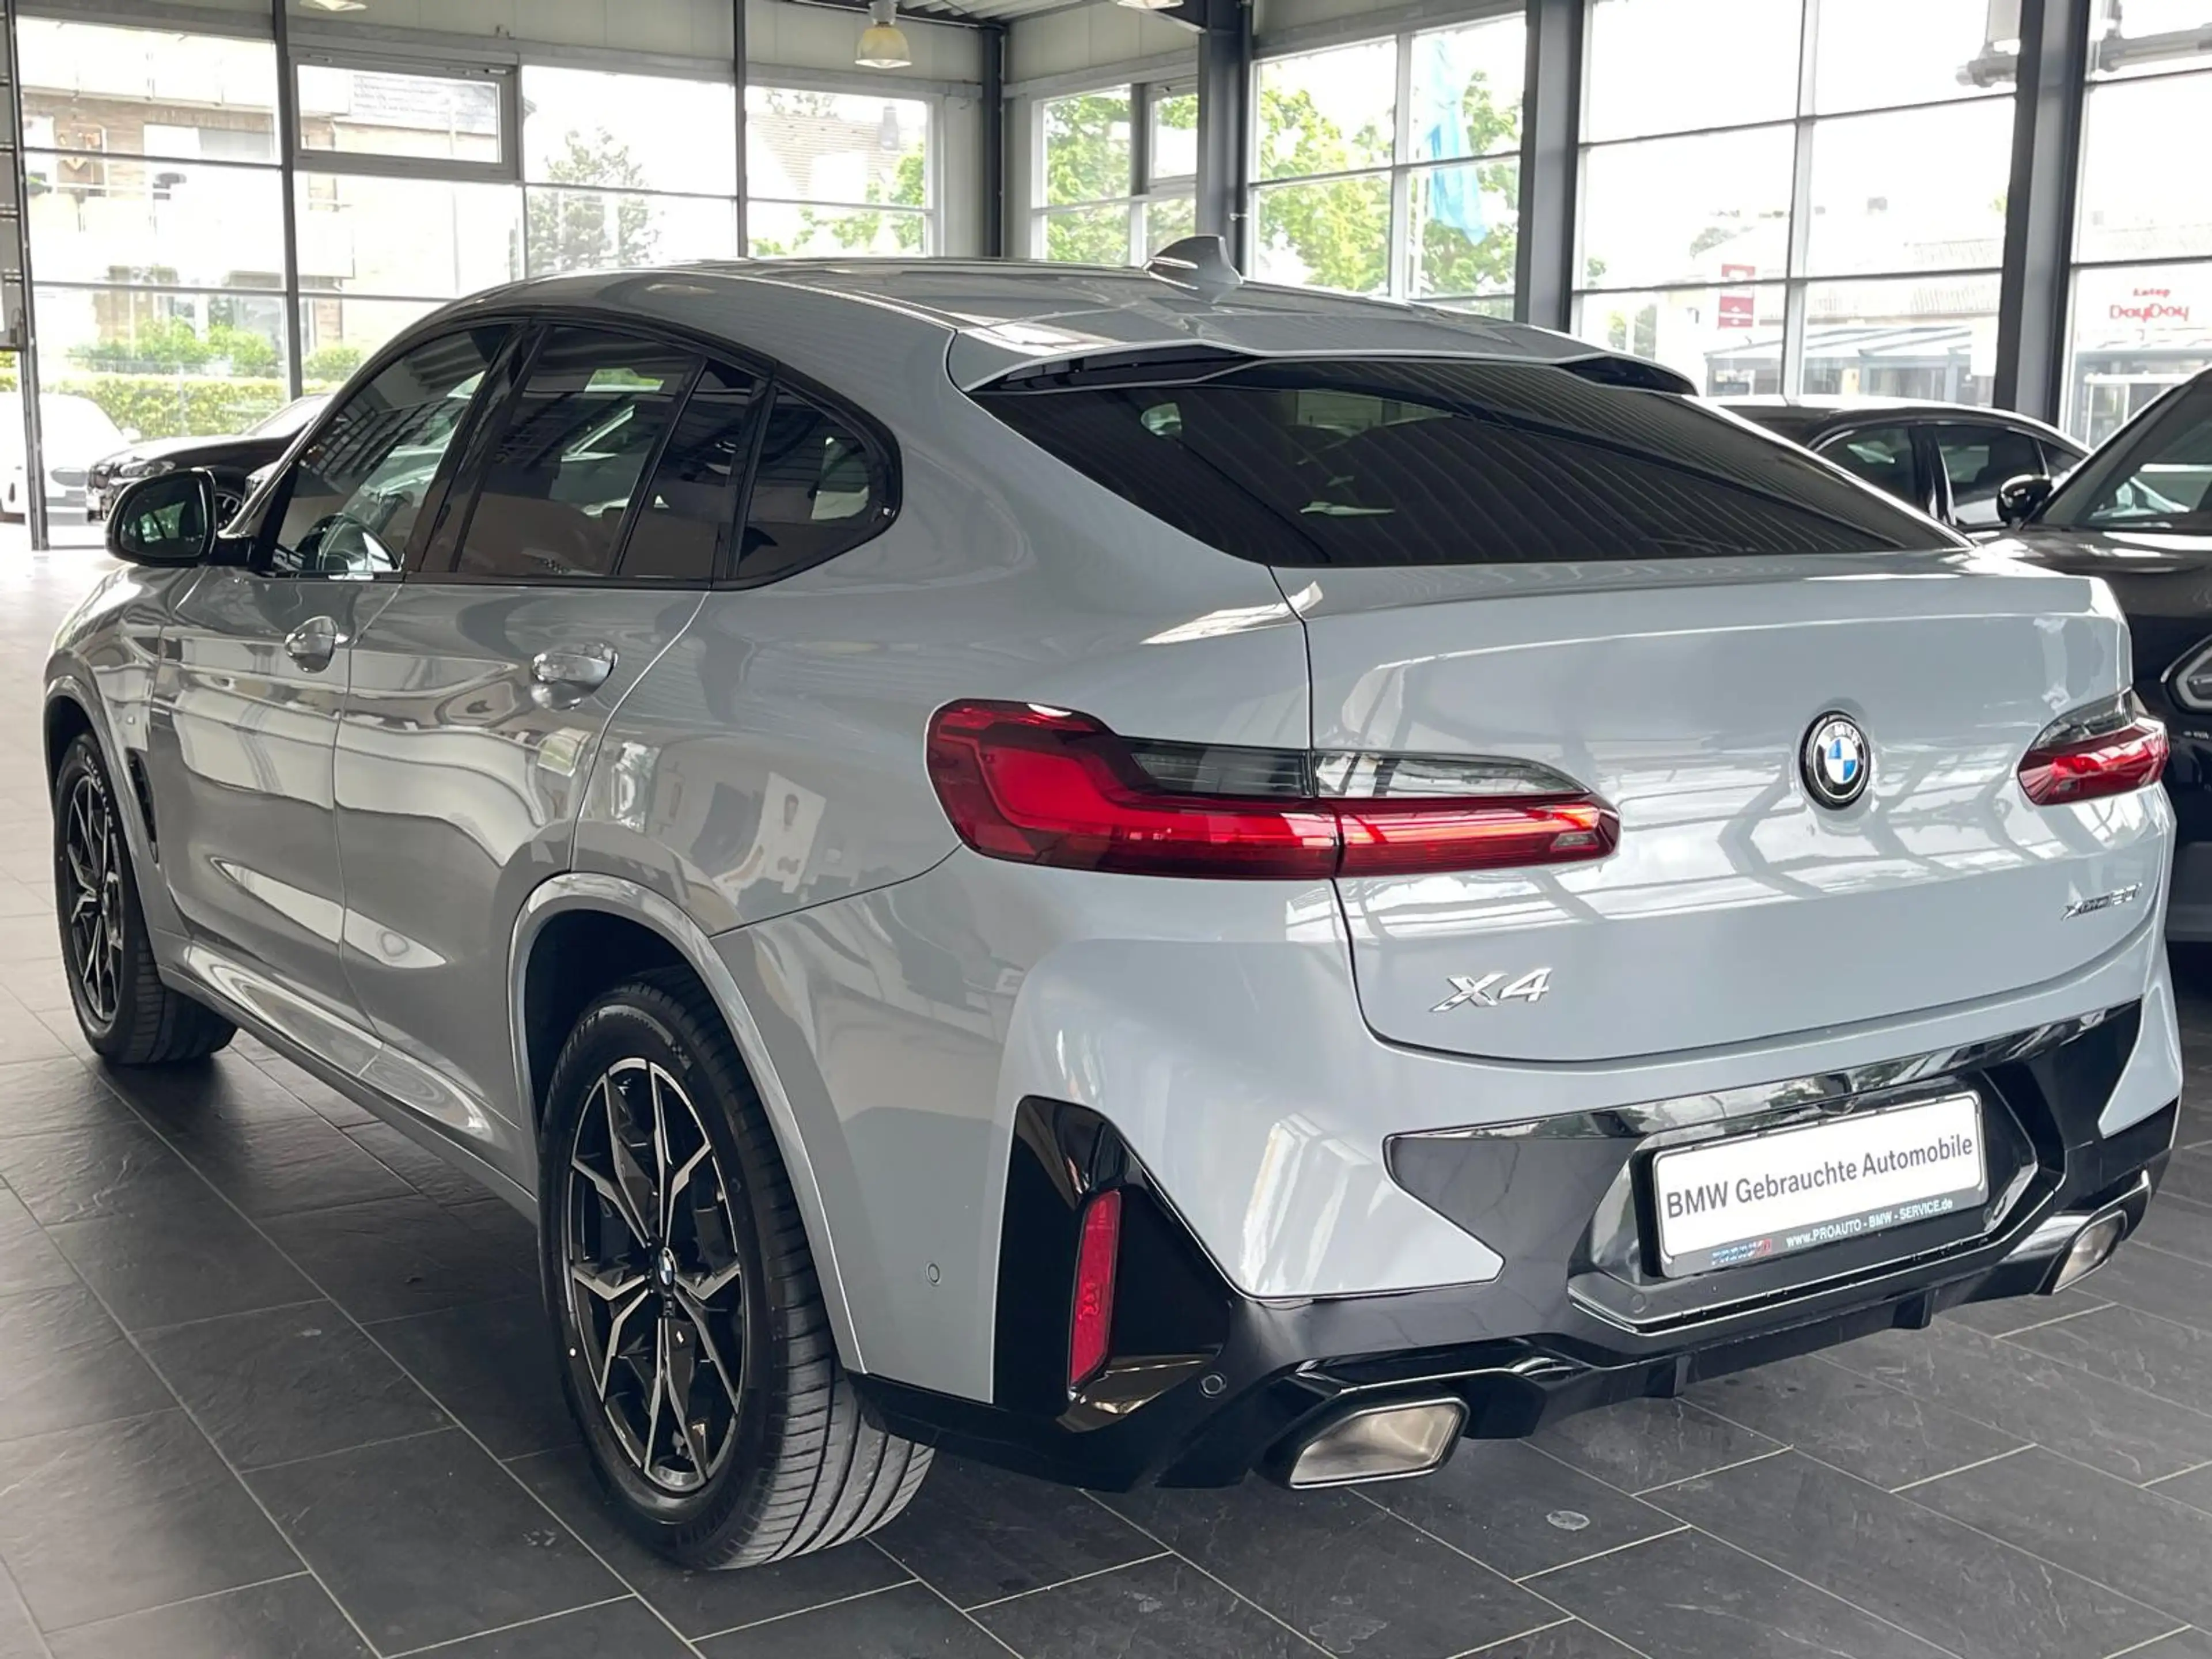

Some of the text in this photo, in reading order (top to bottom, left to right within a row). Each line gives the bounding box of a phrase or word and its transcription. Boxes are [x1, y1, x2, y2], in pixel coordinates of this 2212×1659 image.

[1429, 968, 1552, 1012] X4
[1666, 1133, 1973, 1219] BMW Gebrauchte Automobile
[1869, 1210, 1892, 1228] BMW
